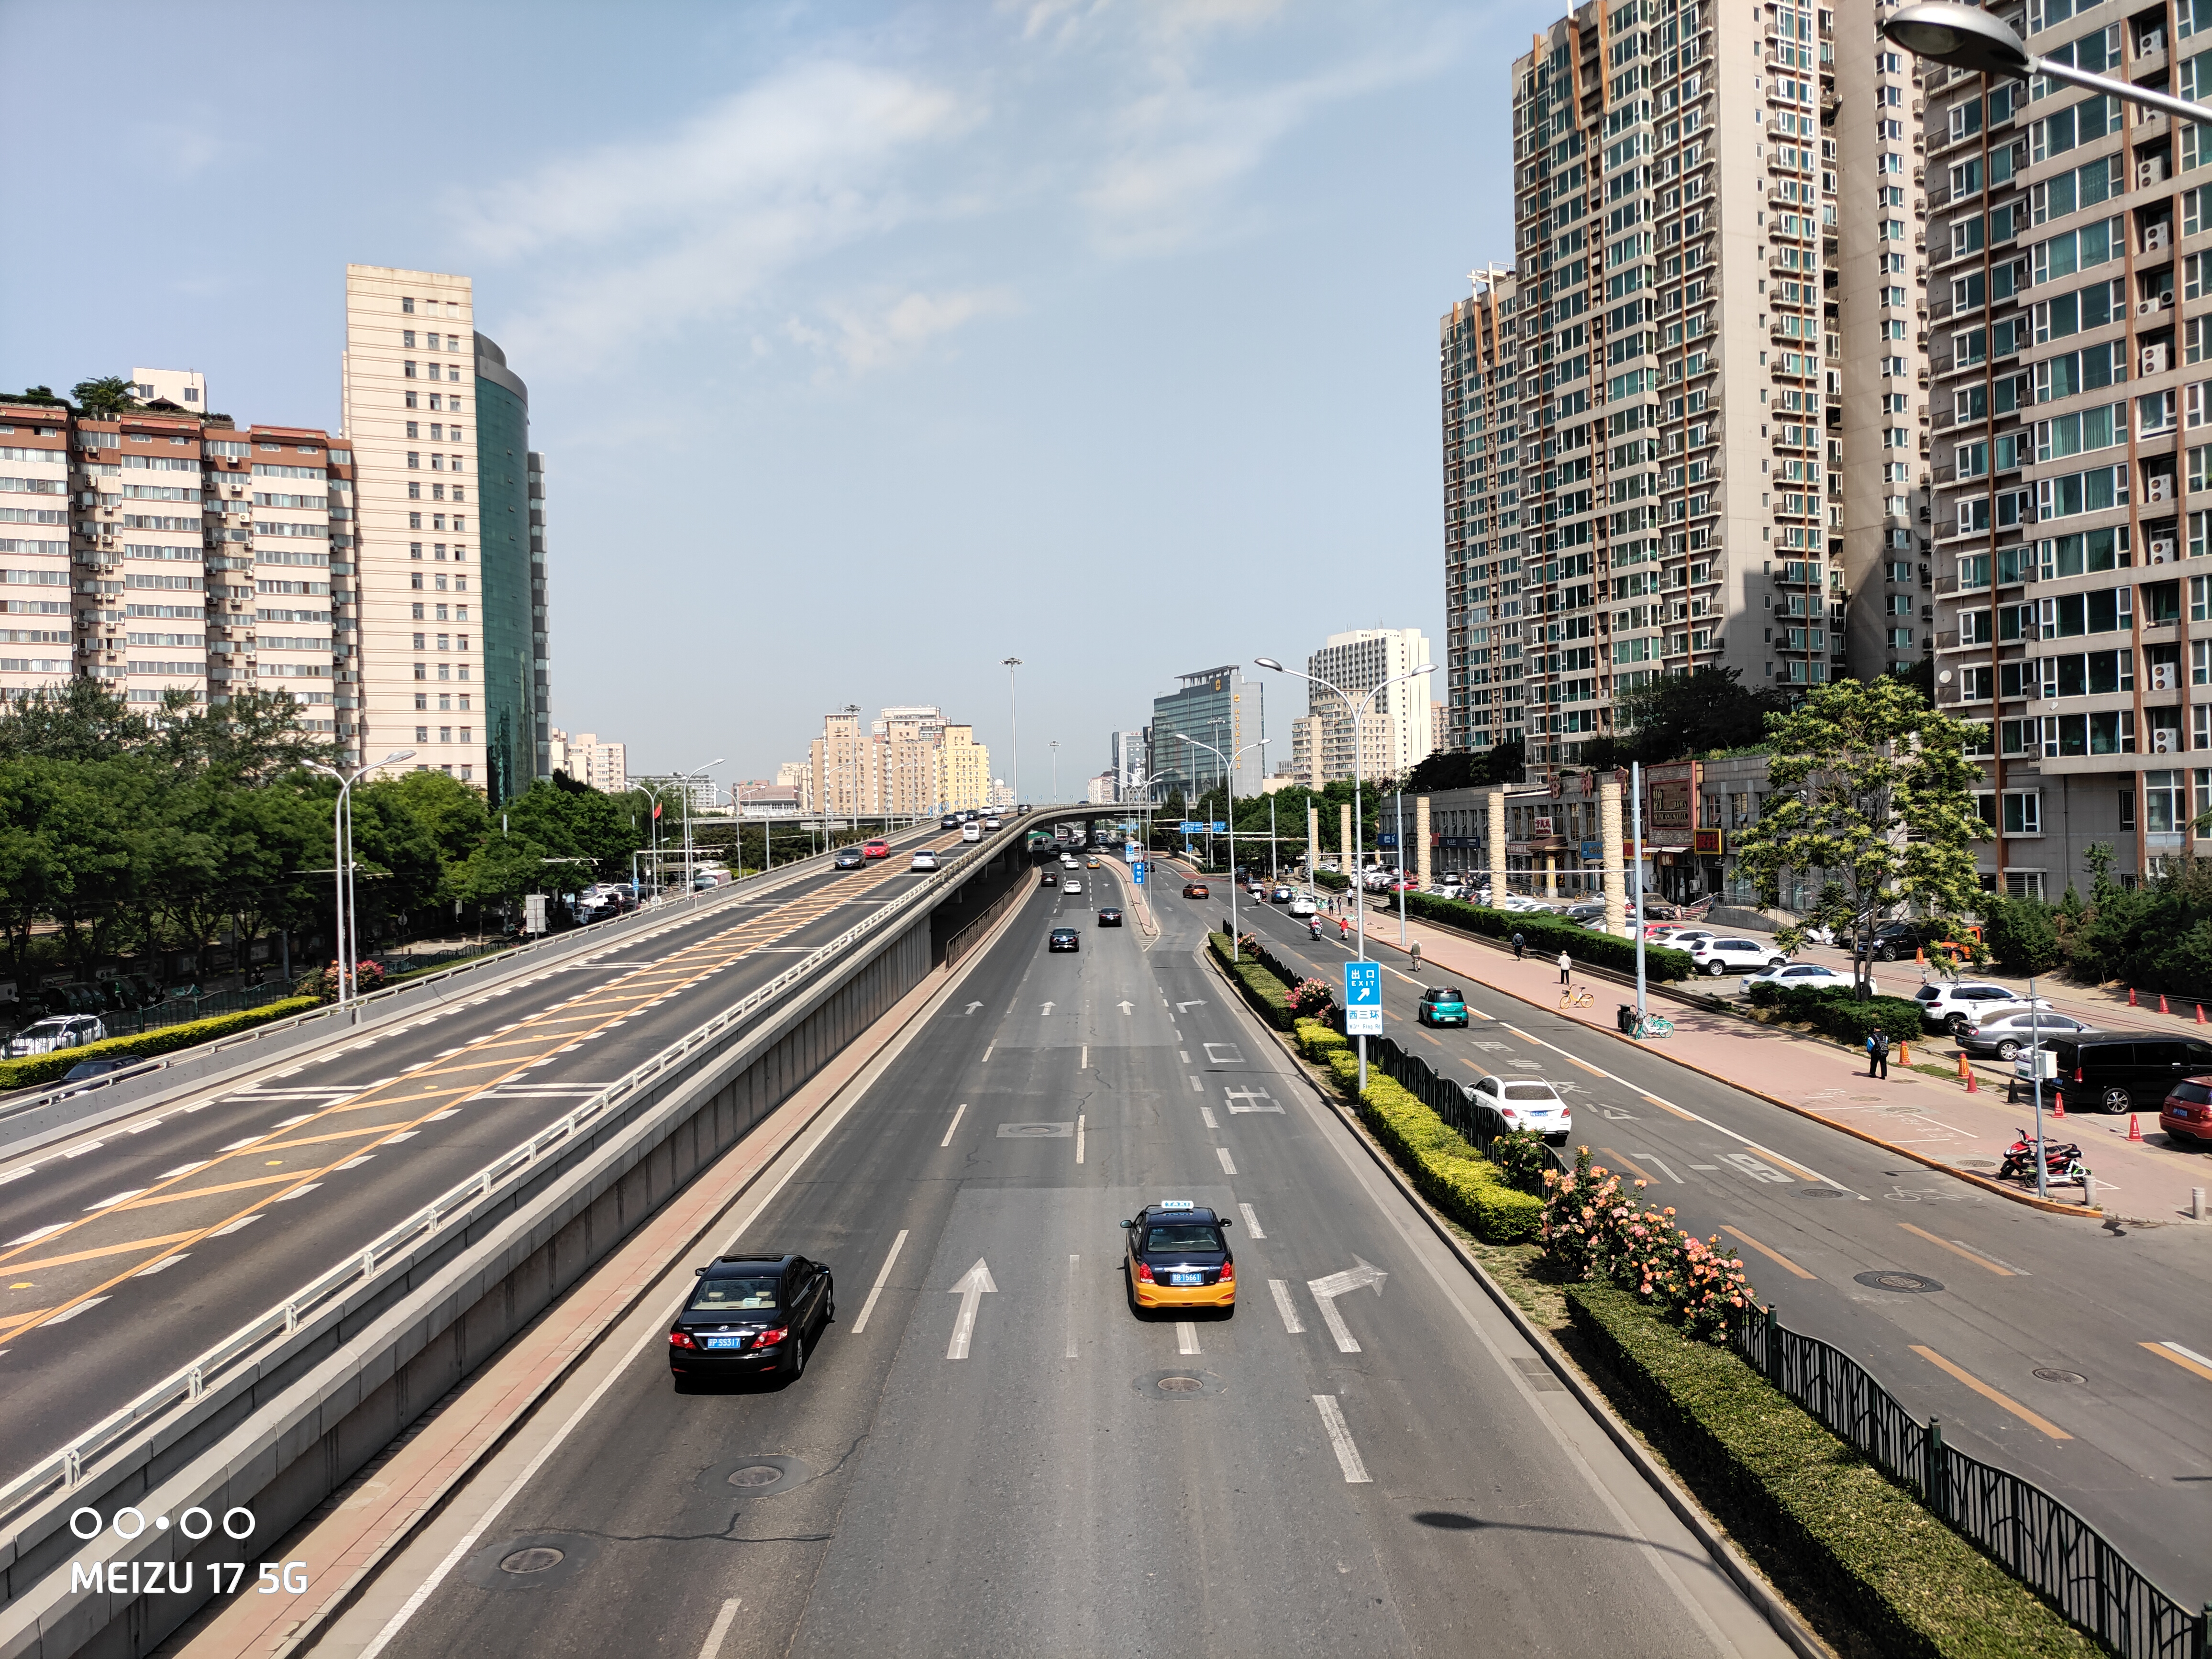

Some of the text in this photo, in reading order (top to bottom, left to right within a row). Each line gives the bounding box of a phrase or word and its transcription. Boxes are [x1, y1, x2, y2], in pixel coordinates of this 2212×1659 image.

[1351, 969, 1375, 979] 出口
[1349, 1010, 1380, 1020] 西三环
